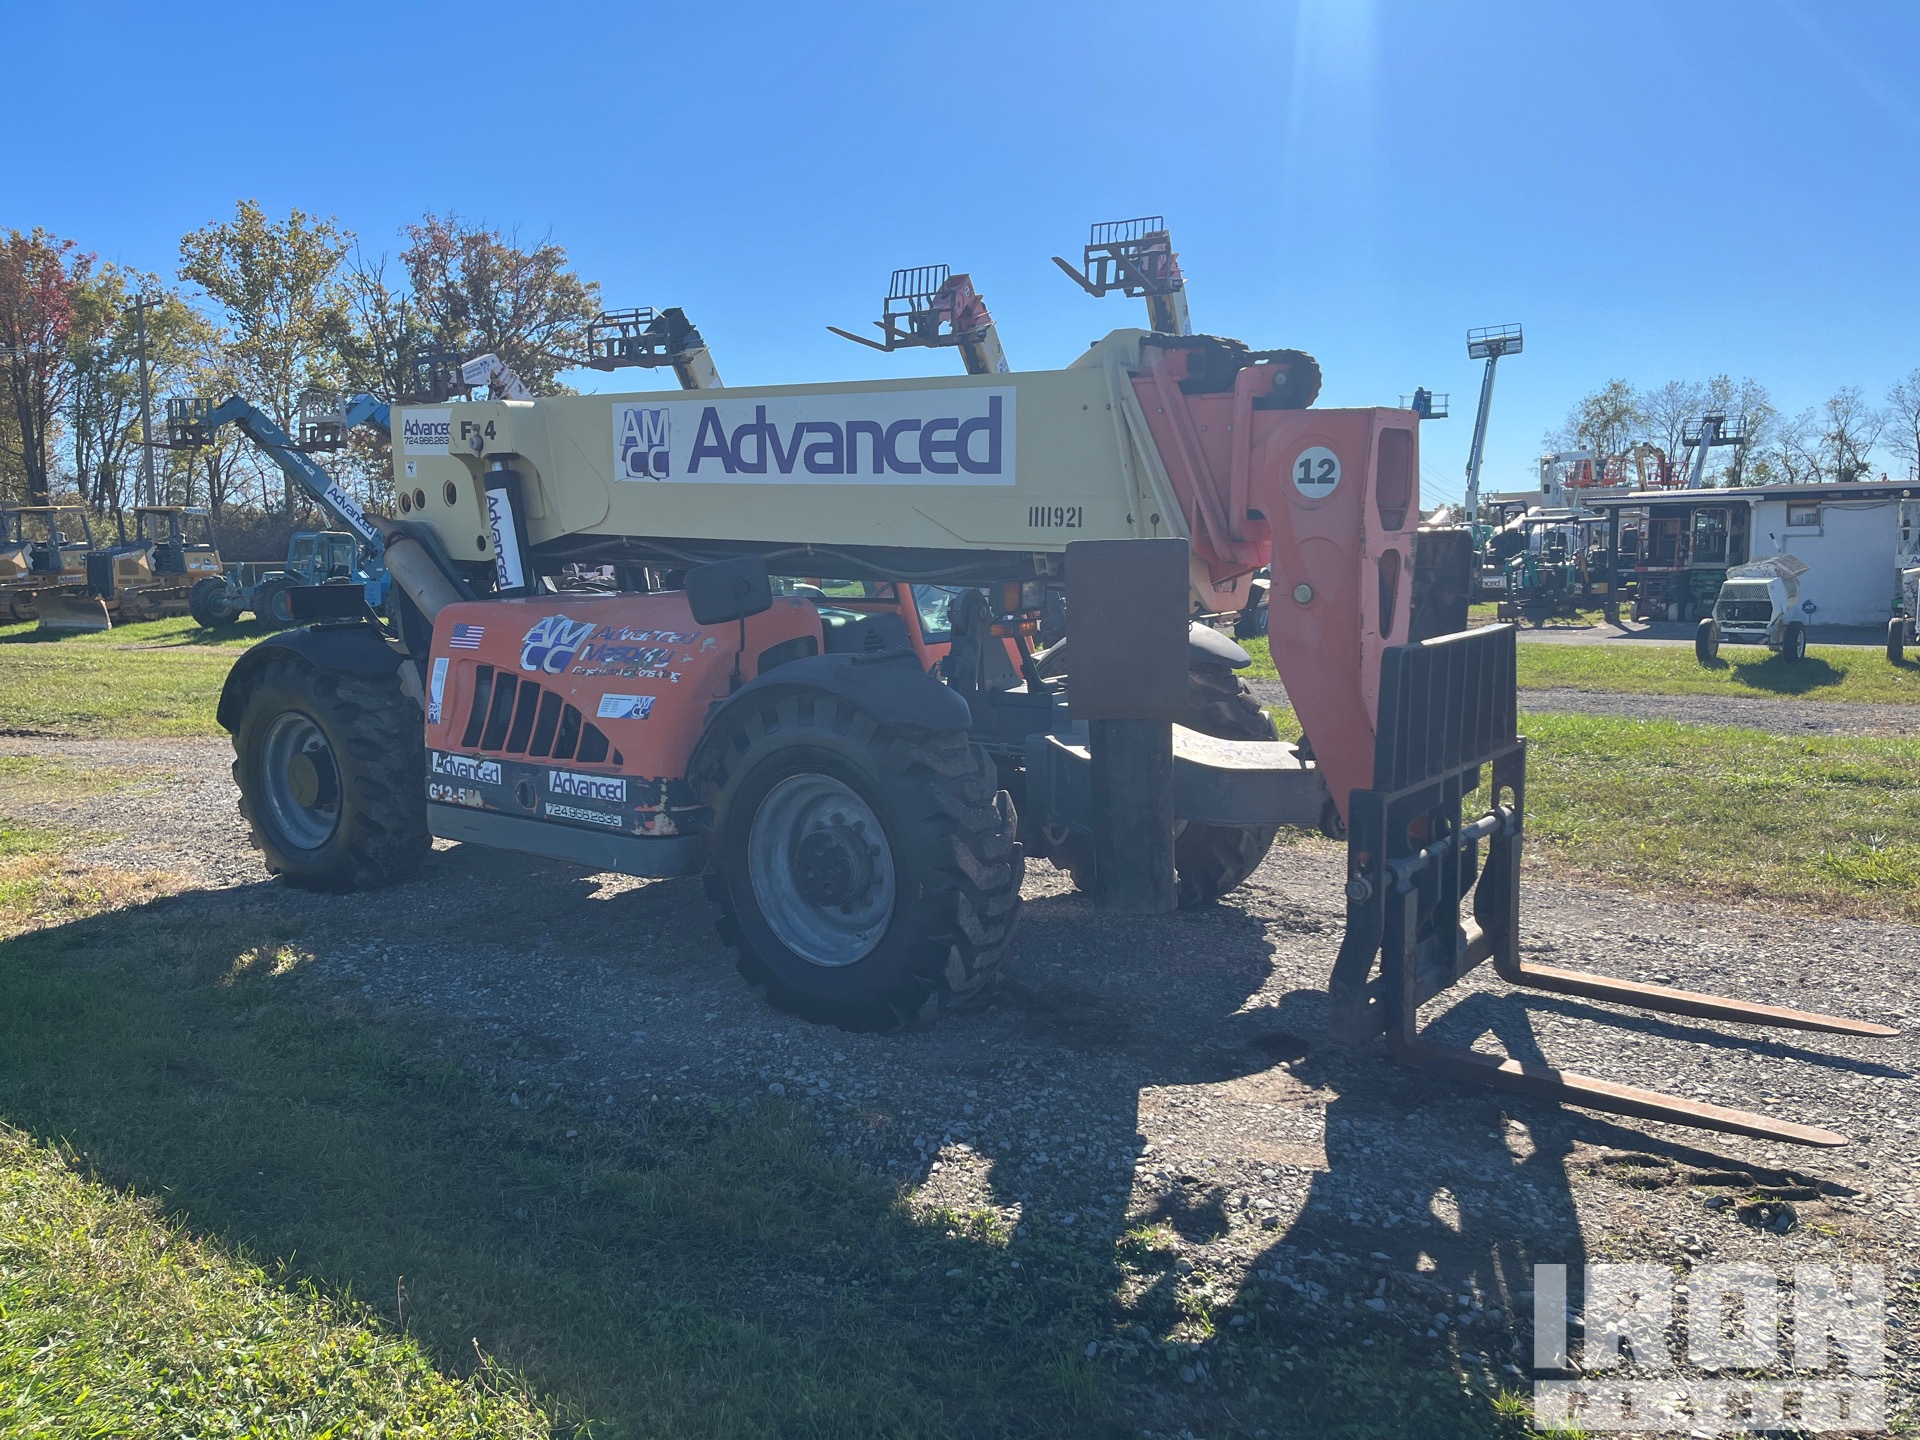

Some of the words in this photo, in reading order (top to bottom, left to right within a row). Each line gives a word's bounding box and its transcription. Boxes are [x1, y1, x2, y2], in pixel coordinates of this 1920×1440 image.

[404, 437, 449, 445] 724.966.263
[687, 395, 1002, 475] Advanced
[1298, 458, 1336, 484] 12
[327, 487, 376, 536] Advanced
[487, 495, 513, 588] Advanced
[552, 771, 624, 802] Advanced
